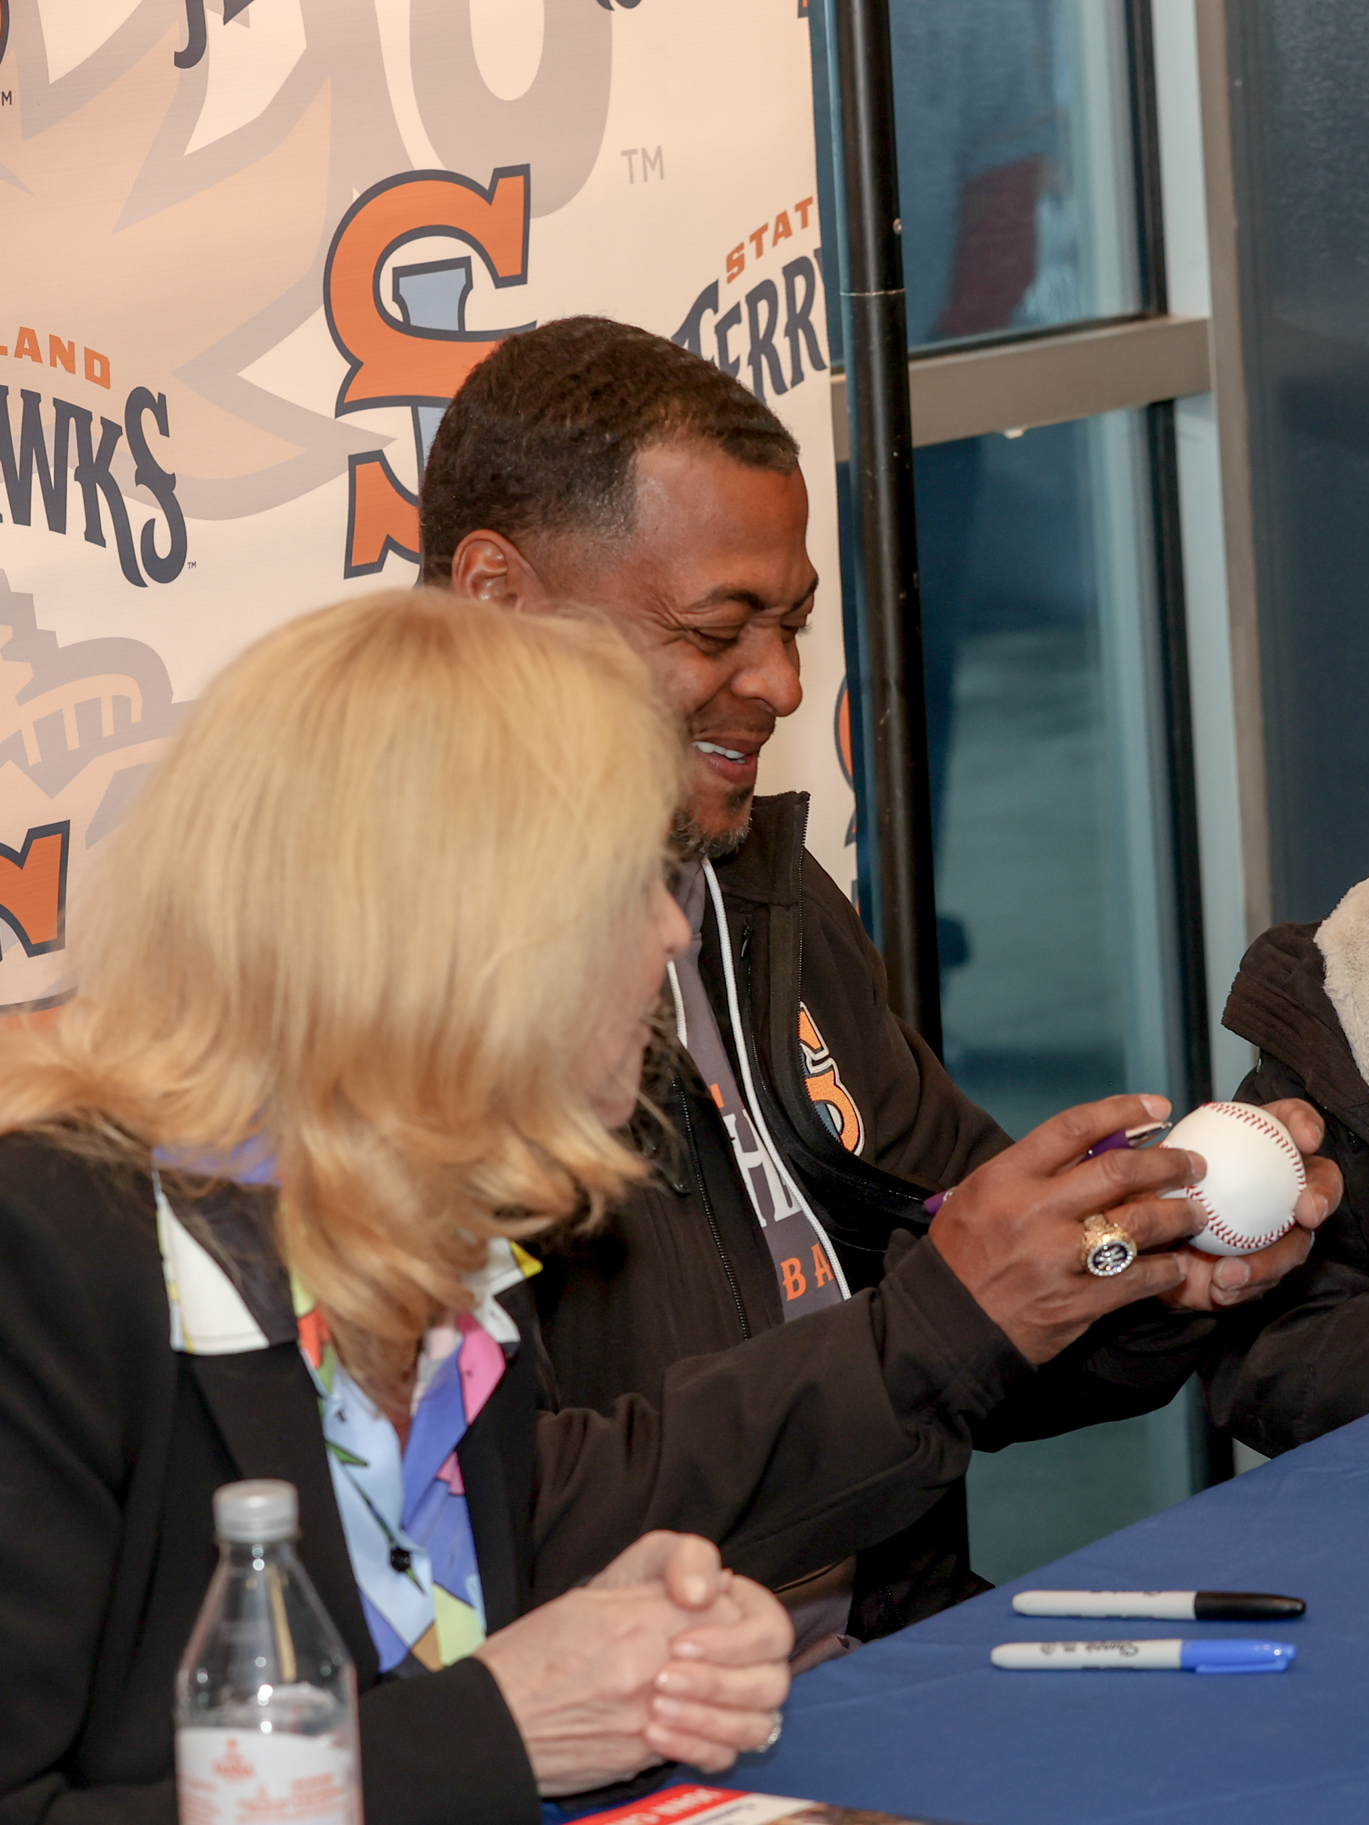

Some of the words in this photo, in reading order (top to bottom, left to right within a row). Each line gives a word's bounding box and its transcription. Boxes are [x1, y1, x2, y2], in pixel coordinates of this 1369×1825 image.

[620, 146, 665, 185] TM
[726, 196, 814, 285] STAT
[0, 326, 111, 390] AND
[671, 247, 827, 406] TERR
[0, 384, 188, 588] WKS
